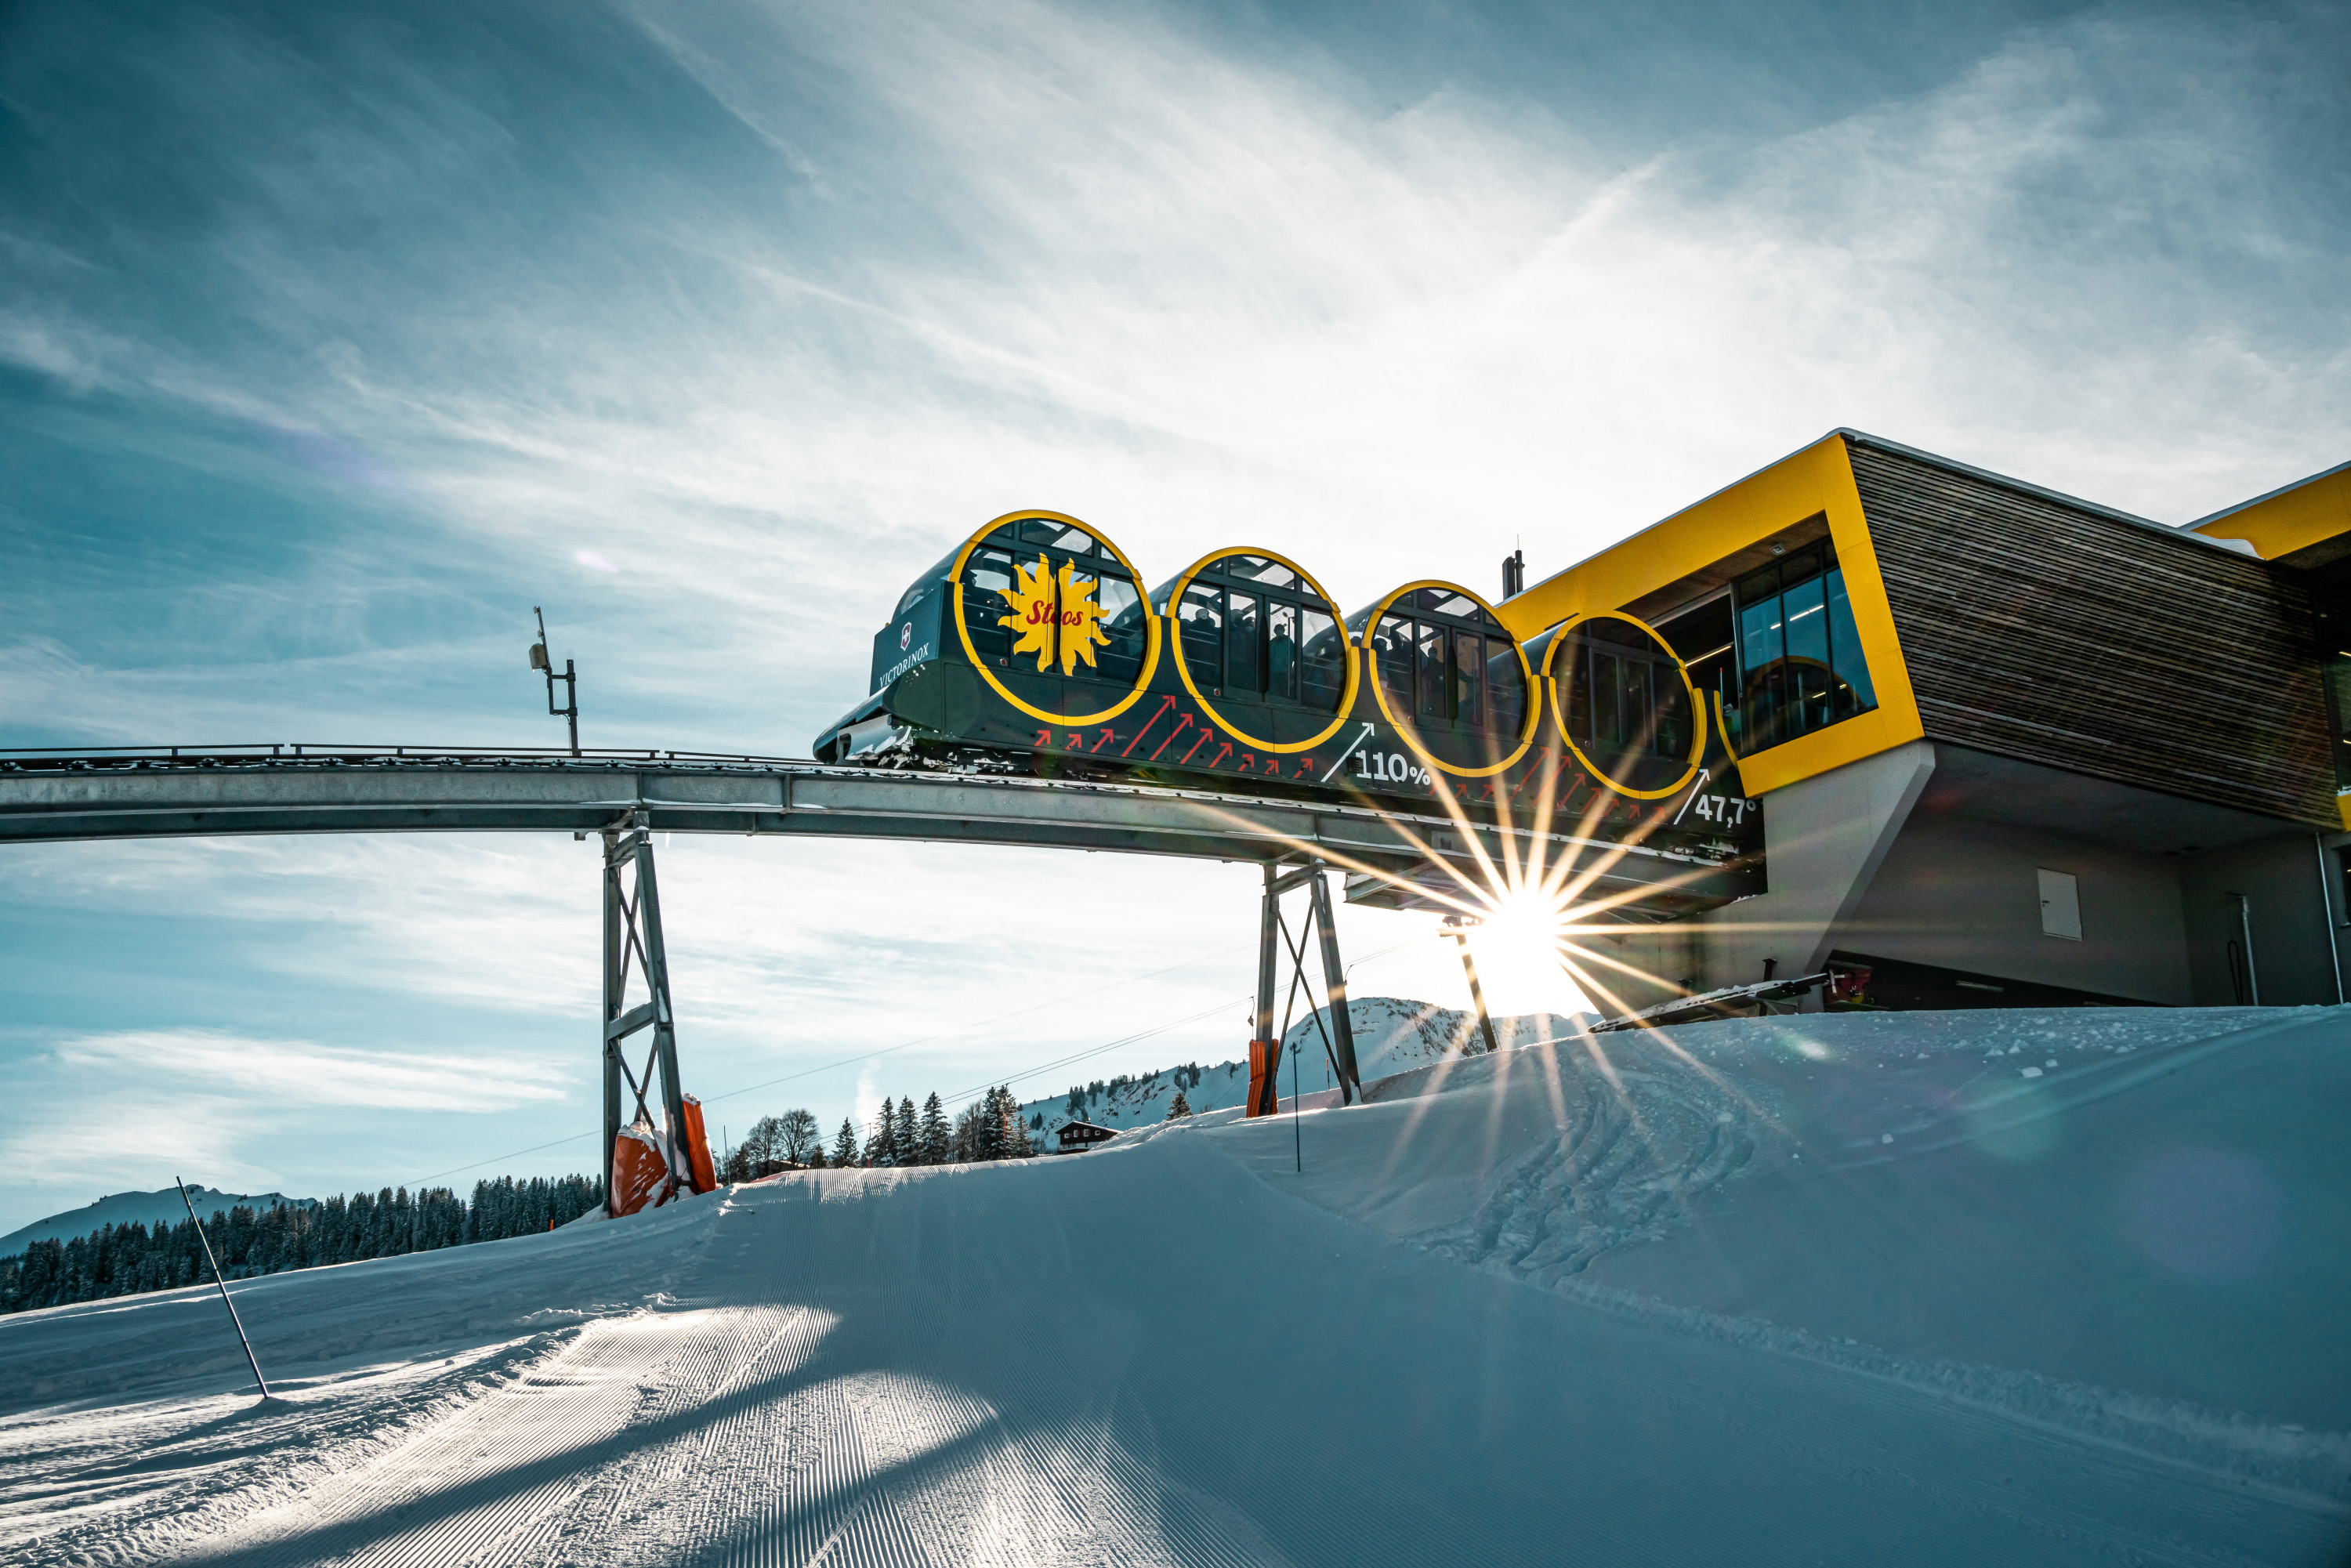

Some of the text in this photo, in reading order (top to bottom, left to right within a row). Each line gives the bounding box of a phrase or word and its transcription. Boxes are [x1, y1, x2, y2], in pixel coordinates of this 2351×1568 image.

[879, 642, 929, 688] VICTORINOX
[1355, 749, 1431, 786] 110%
[1695, 794, 1756, 828] 47,7°
